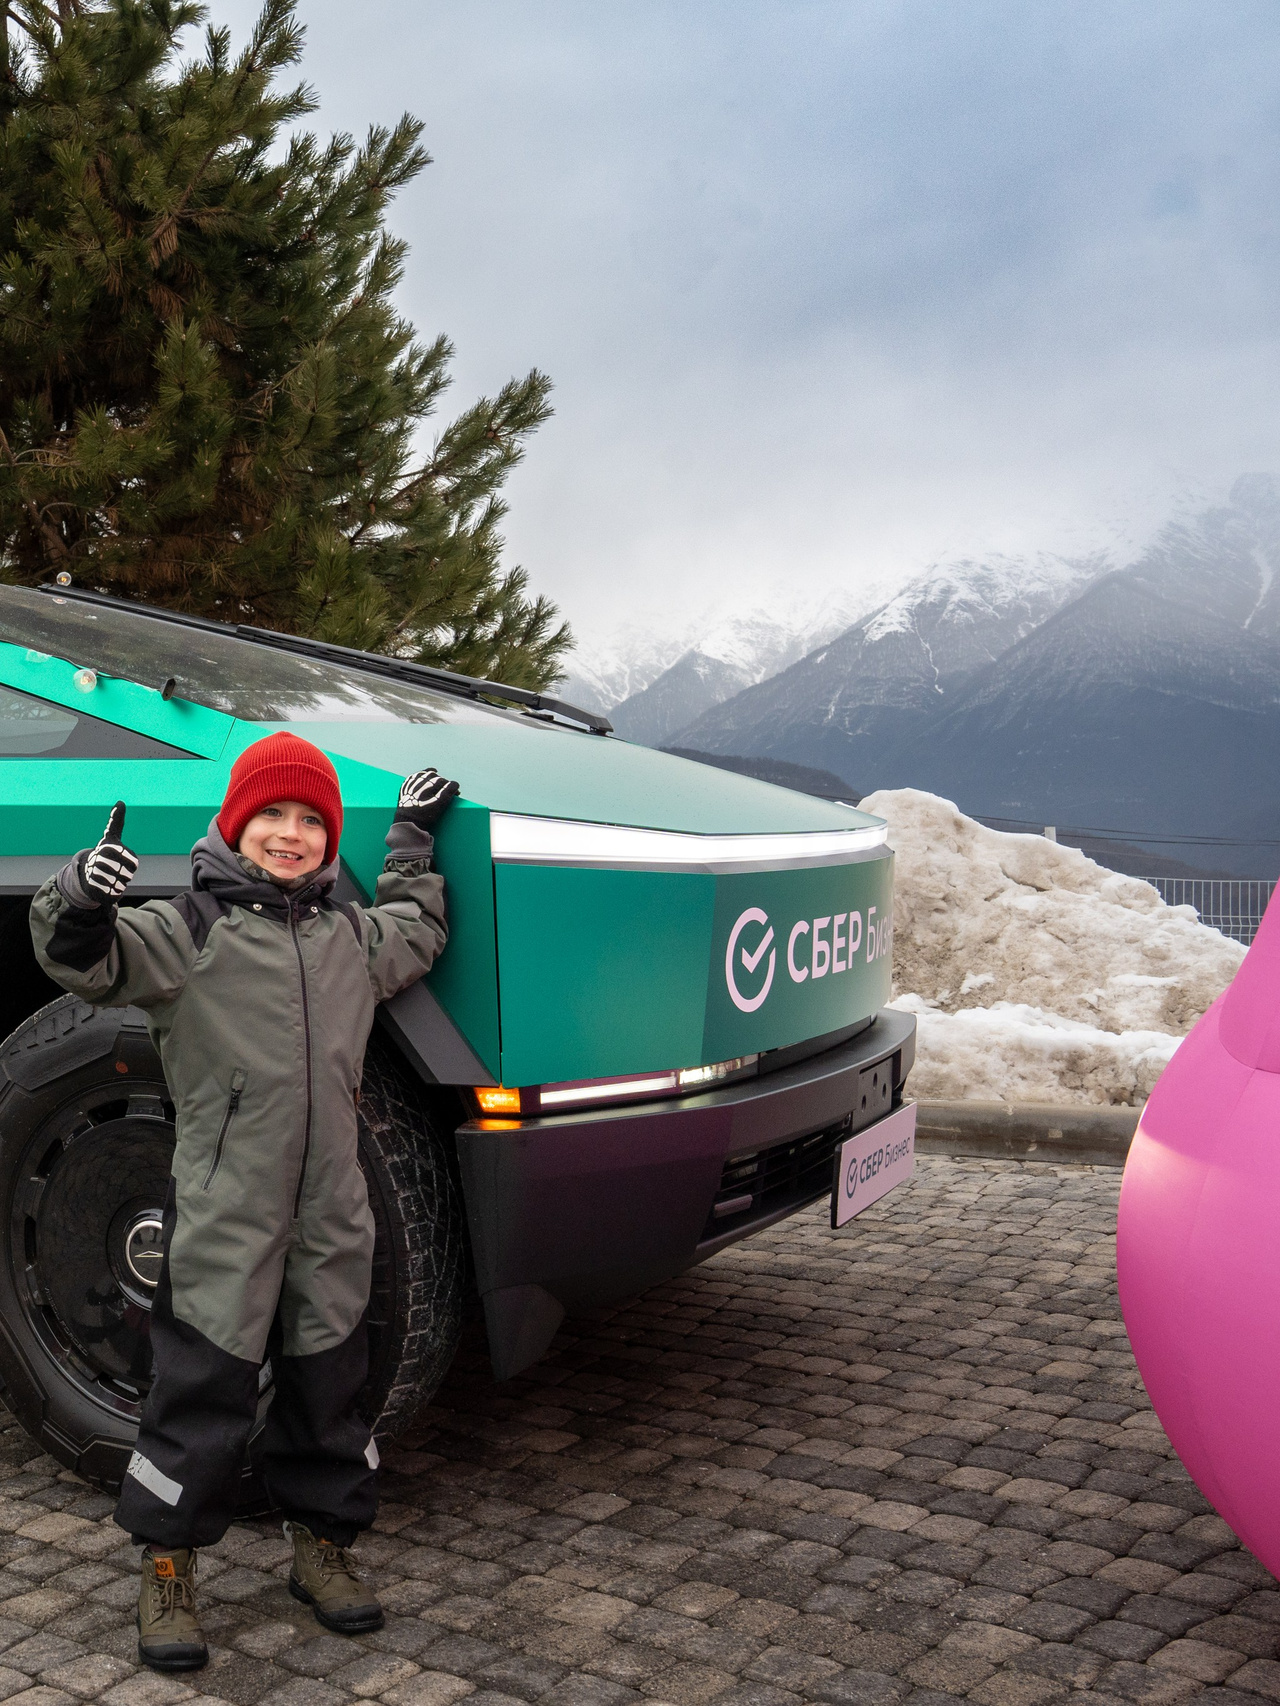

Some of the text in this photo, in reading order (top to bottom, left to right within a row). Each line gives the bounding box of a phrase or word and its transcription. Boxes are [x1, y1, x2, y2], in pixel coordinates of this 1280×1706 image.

[787, 910, 862, 983] СБЕР
[860, 1137, 910, 1184] СБЕР Бизнес
